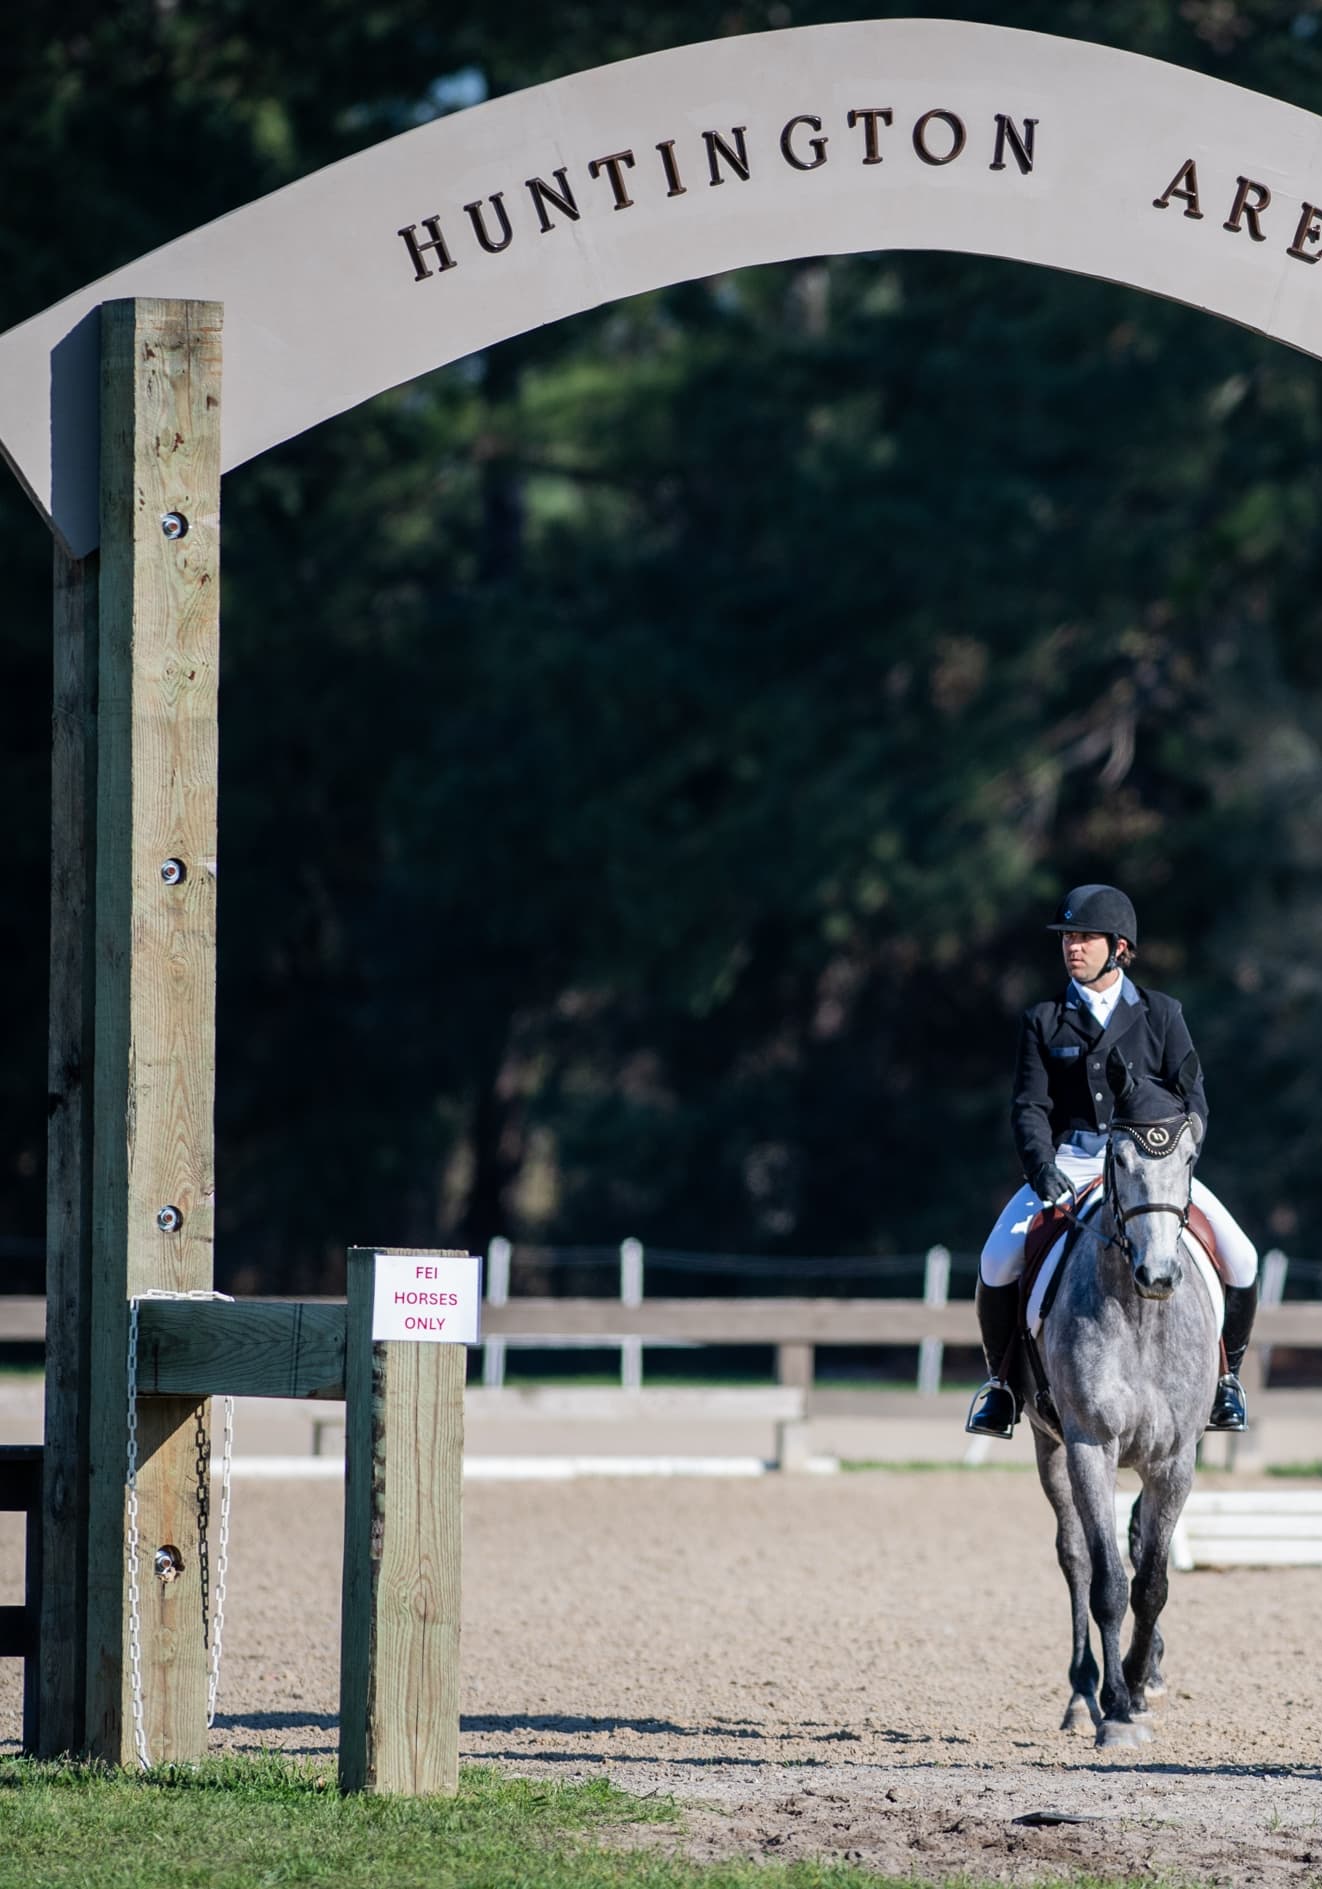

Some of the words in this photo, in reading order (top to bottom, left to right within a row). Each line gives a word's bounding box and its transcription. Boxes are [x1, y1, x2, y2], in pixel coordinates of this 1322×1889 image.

[397, 107, 1040, 281] HUNTINGTON
[415, 1266, 438, 1279] FEI
[394, 1291, 458, 1306] HORSES
[404, 1316, 446, 1330] ONLY
